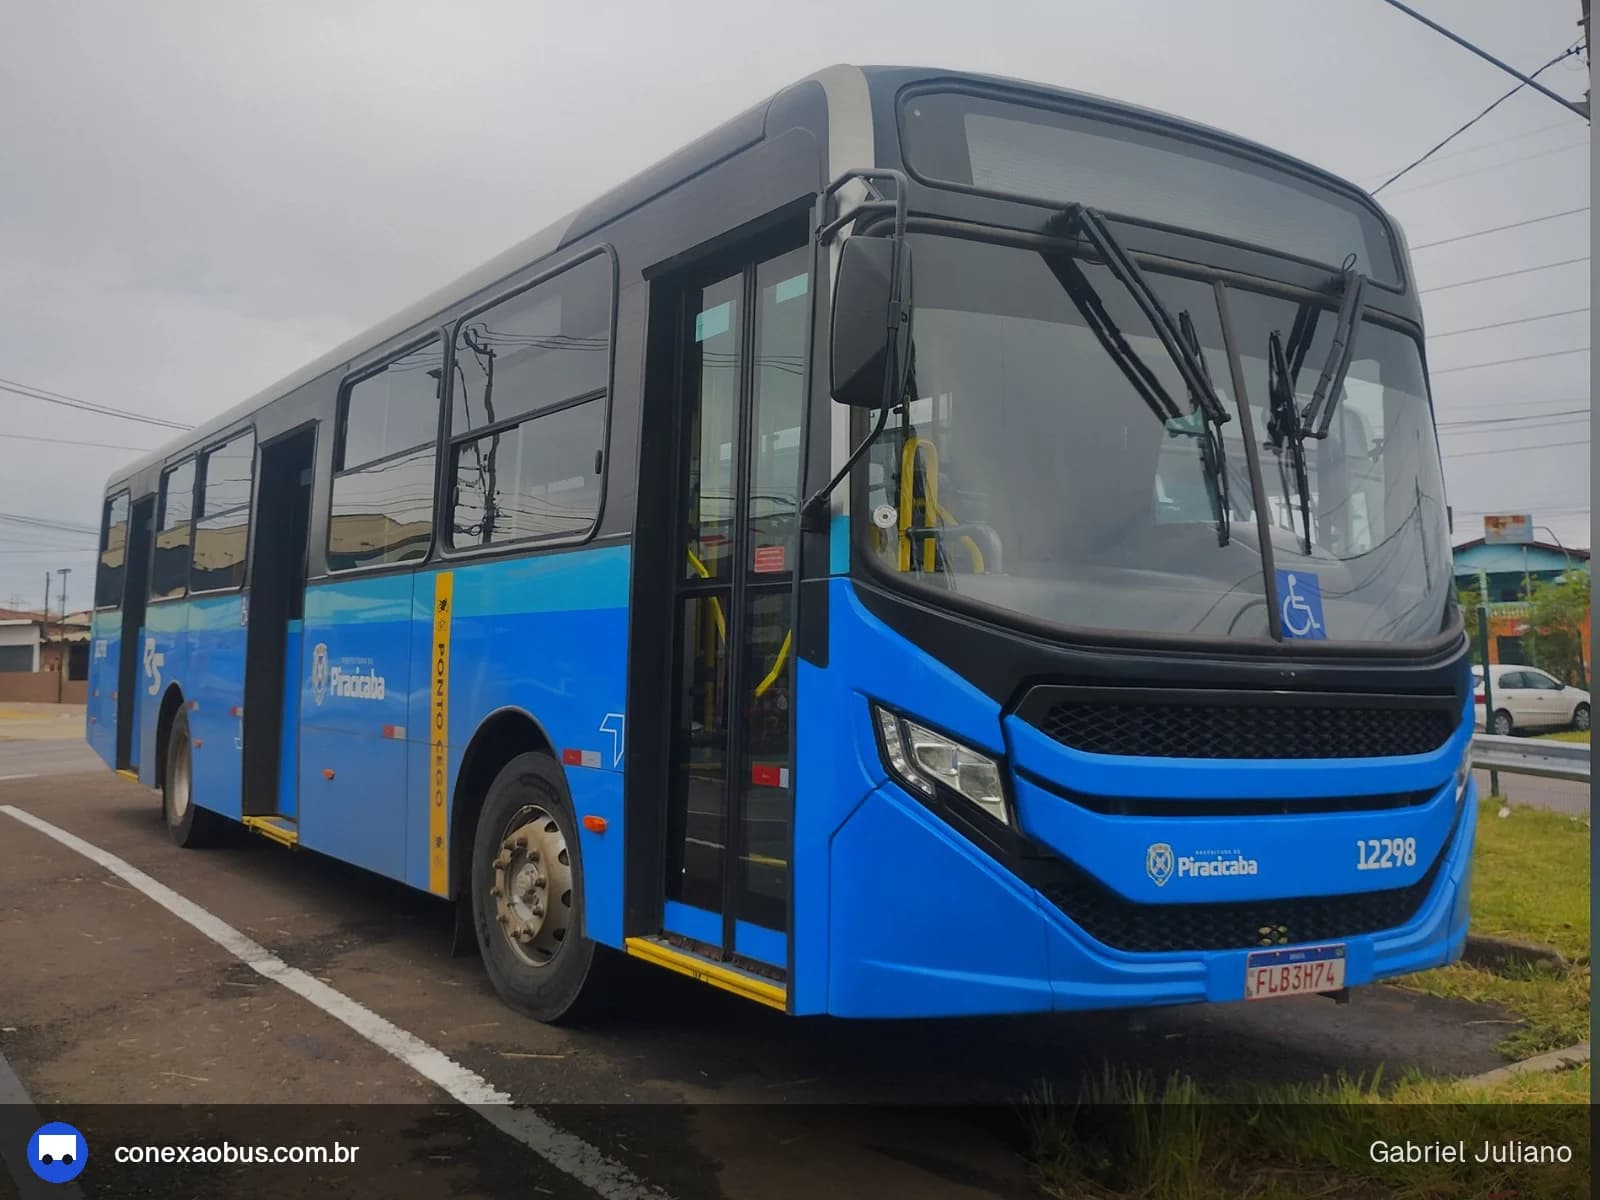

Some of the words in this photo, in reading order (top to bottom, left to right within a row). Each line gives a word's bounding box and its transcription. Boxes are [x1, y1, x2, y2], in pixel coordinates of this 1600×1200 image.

[330, 666, 385, 700] Piracicaba
[436, 643, 445, 730] PONTO
[435, 740, 443, 808] CEGO
[1178, 855, 1258, 877] Piracicaba
[1357, 837, 1416, 870] 12298
[1256, 962, 1335, 994] FLB3H74
